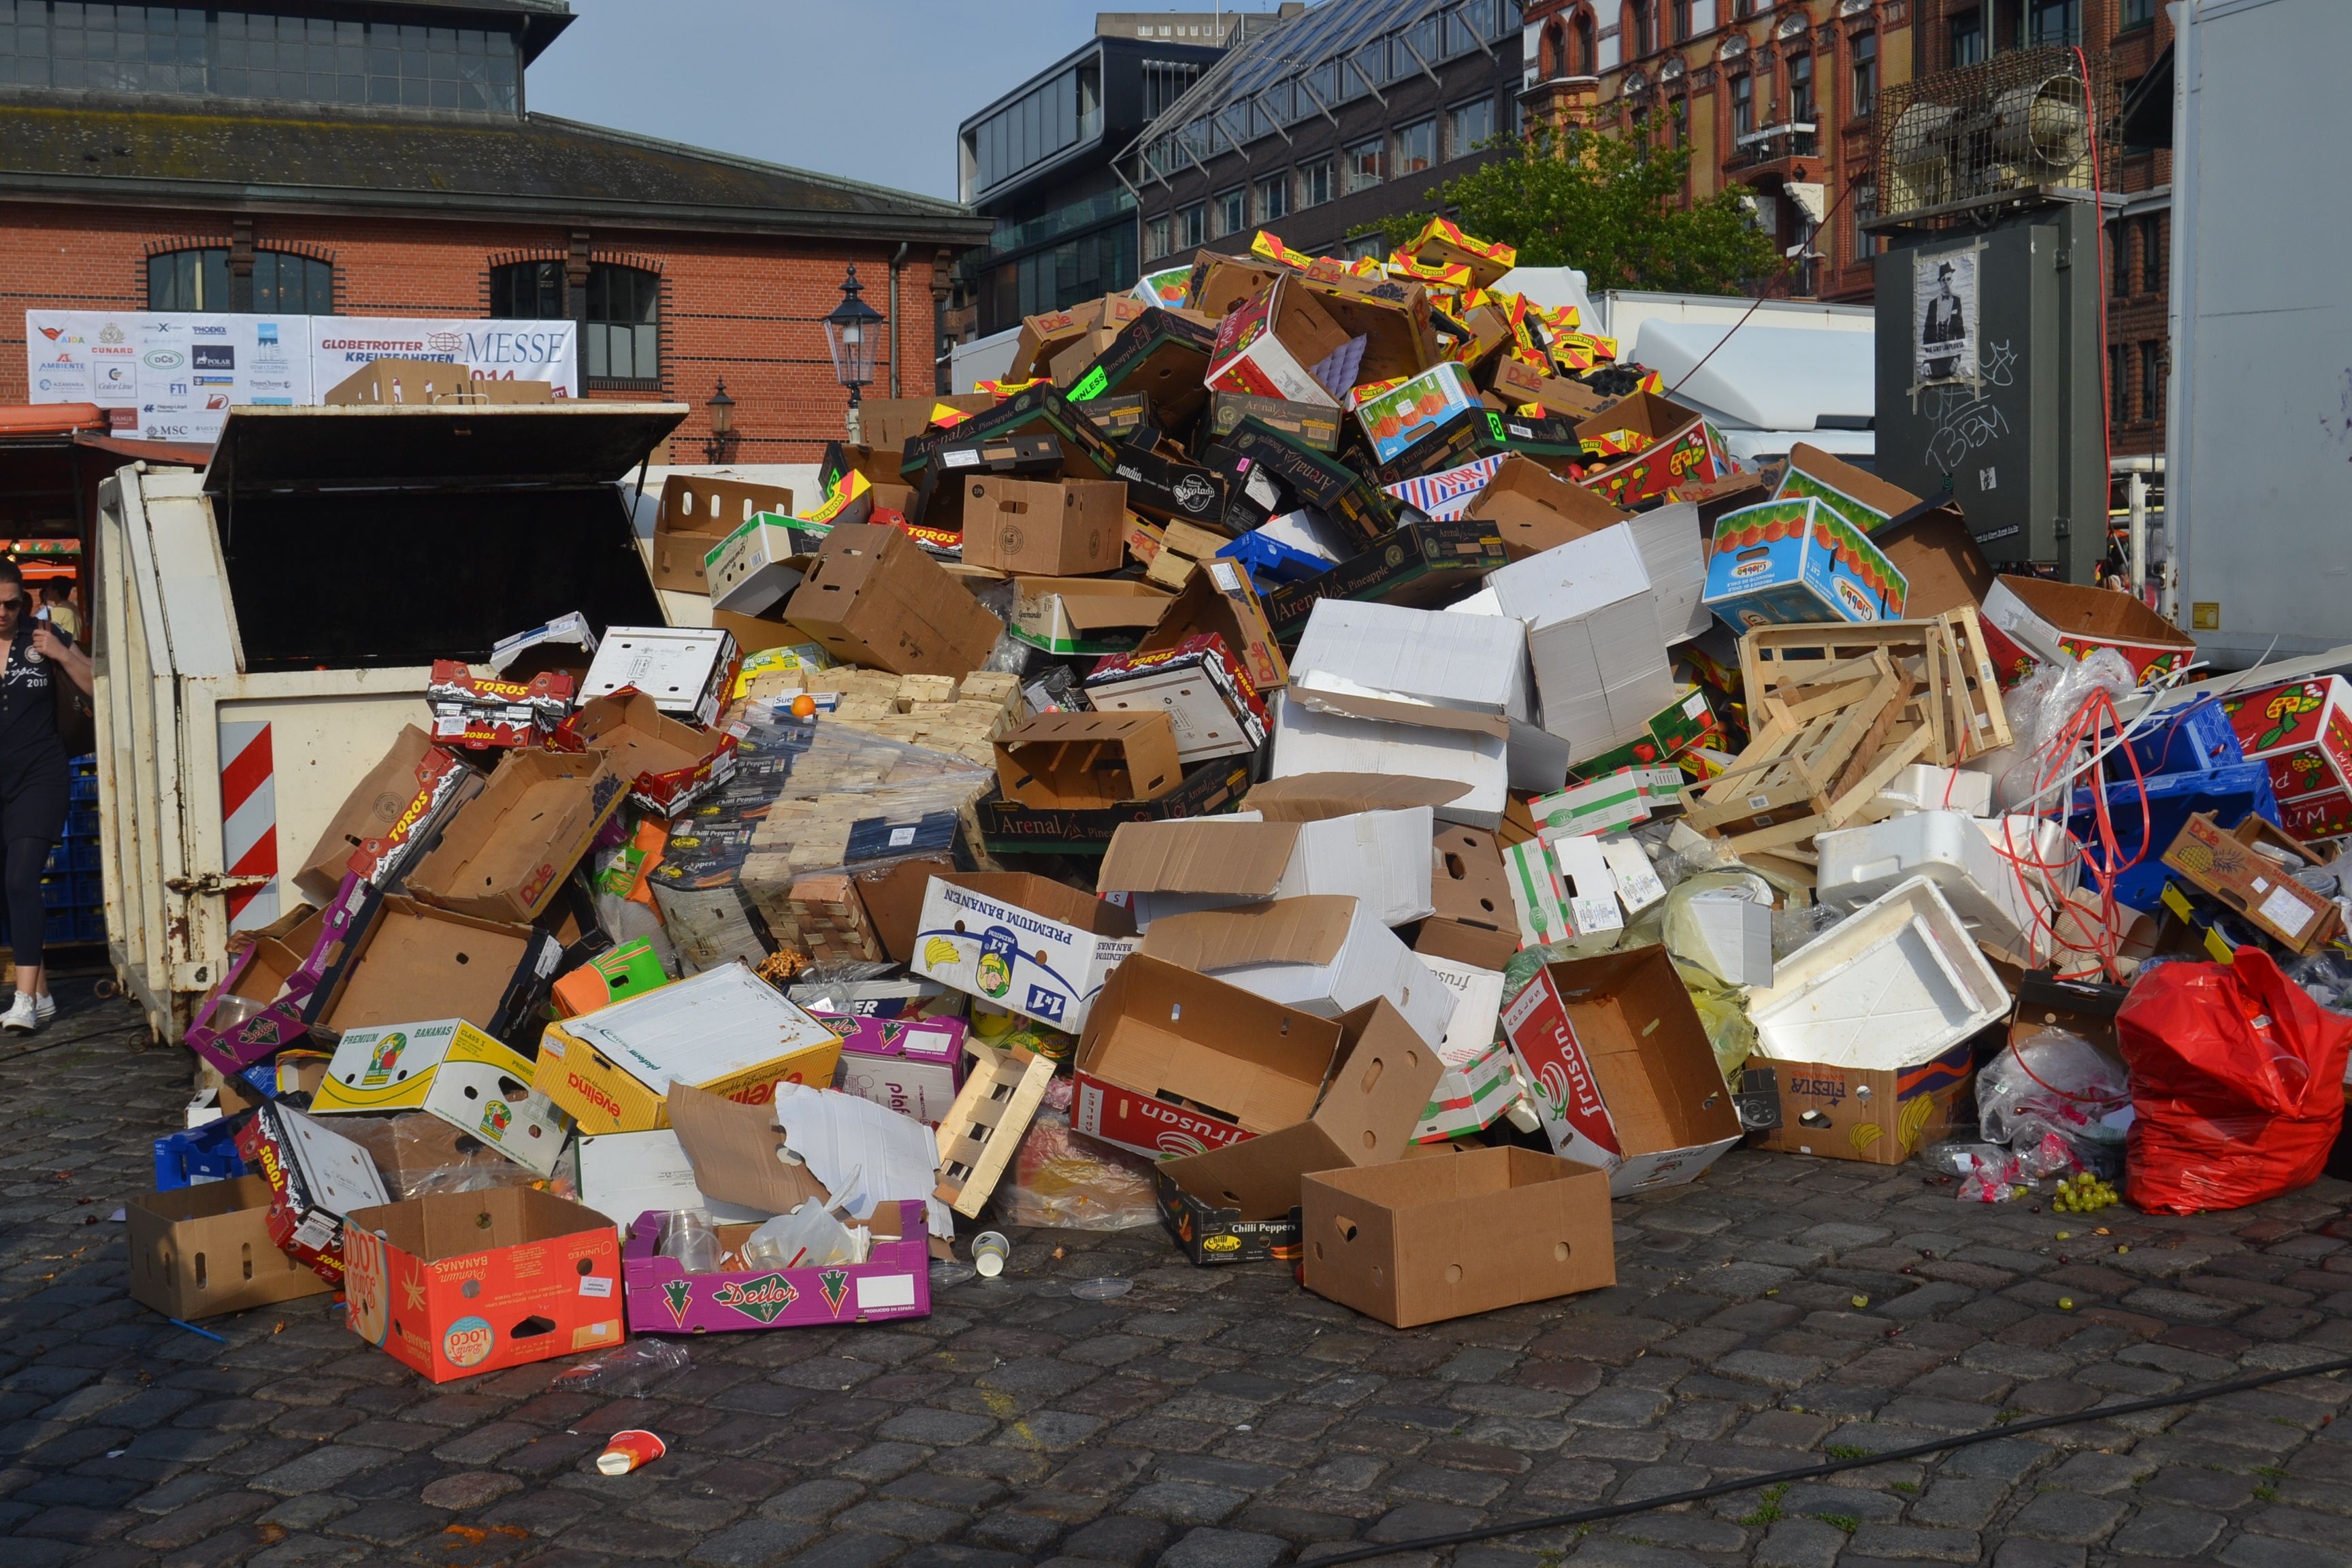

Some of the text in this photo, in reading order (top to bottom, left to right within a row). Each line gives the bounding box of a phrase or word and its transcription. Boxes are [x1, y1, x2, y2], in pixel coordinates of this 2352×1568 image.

[1462, 238, 1489, 255] SHARON
[1284, 252, 1311, 267] SHARON
[1308, 265, 1341, 282] Dole
[1411, 265, 1445, 276] SHARON
[1115, 302, 1144, 320] Dol
[1039, 314, 1072, 331] Dole
[322, 339, 423, 350] GLOBETROTTER
[1515, 324, 1529, 351] SHARON
[1563, 334, 1595, 346] SHARON
[463, 333, 565, 363] MESSE
[345, 352, 455, 363] KREUZFAHRTEN
[1103, 344, 1138, 374] Pineapple
[39, 363, 85, 372] AMBIENTE
[1507, 365, 1543, 390] Dole
[170, 384, 186, 393] FTI
[1360, 385, 1386, 397] SHARON
[978, 409, 1015, 431] Pineapple
[161, 426, 188, 435] MSC
[1287, 458, 1336, 492] Arenal
[1437, 467, 1484, 487] D'OR
[812, 494, 845, 523] SHARON
[907, 527, 958, 543] TOROS
[1279, 565, 1389, 622] Arenal Pineapple
[1126, 650, 1177, 668] TOROS
[1251, 641, 1275, 683] Dole
[27, 679, 48, 687] 2010
[474, 679, 529, 696] TOROS
[1233, 666, 1256, 698] TOROS
[719, 675, 734, 714] TOROS
[463, 730, 496, 741] TOROS
[693, 763, 714, 779] TORO
[717, 795, 764, 806] Chilli Peppers
[389, 789, 429, 843] TOROS
[1002, 813, 1115, 840] Arenal Pinea
[2189, 819, 2221, 847] Dole
[519, 862, 557, 905] Dole
[2270, 868, 2330, 909] SUPER SWEET
[943, 887, 1074, 946] PREMIUM BANANEN
[1096, 942, 1132, 951] BANANAS
[1435, 970, 1471, 992] frus
[342, 1025, 455, 1045] PREMIUM BANANAS
[823, 1018, 862, 1035] eilor
[460, 1029, 480, 1044] CLASS
[511, 1059, 535, 1077] PRODUC
[1554, 1026, 1604, 1119] frusan
[566, 1071, 621, 1120] evelina
[1791, 1077, 1846, 1099] FIESTA
[259, 1144, 284, 1192] TOROS
[1231, 1222, 1296, 1234] Chilli Peppers
[1207, 1235, 1228, 1246] Chilli
[1214, 1242, 1236, 1252] Zahavi
[344, 1228, 380, 1275] LOCO
[568, 1247, 600, 1259] UNIVEG
[316, 1253, 346, 1272] OROS
[435, 1255, 489, 1274] BANANAS
[440, 1268, 486, 1284] Premium
[720, 1281, 800, 1307] Deilor
[864, 1306, 890, 1314] PRODUCIDO
[897, 1304, 915, 1312] ESPAÑA
[451, 1328, 487, 1346] LOCO
